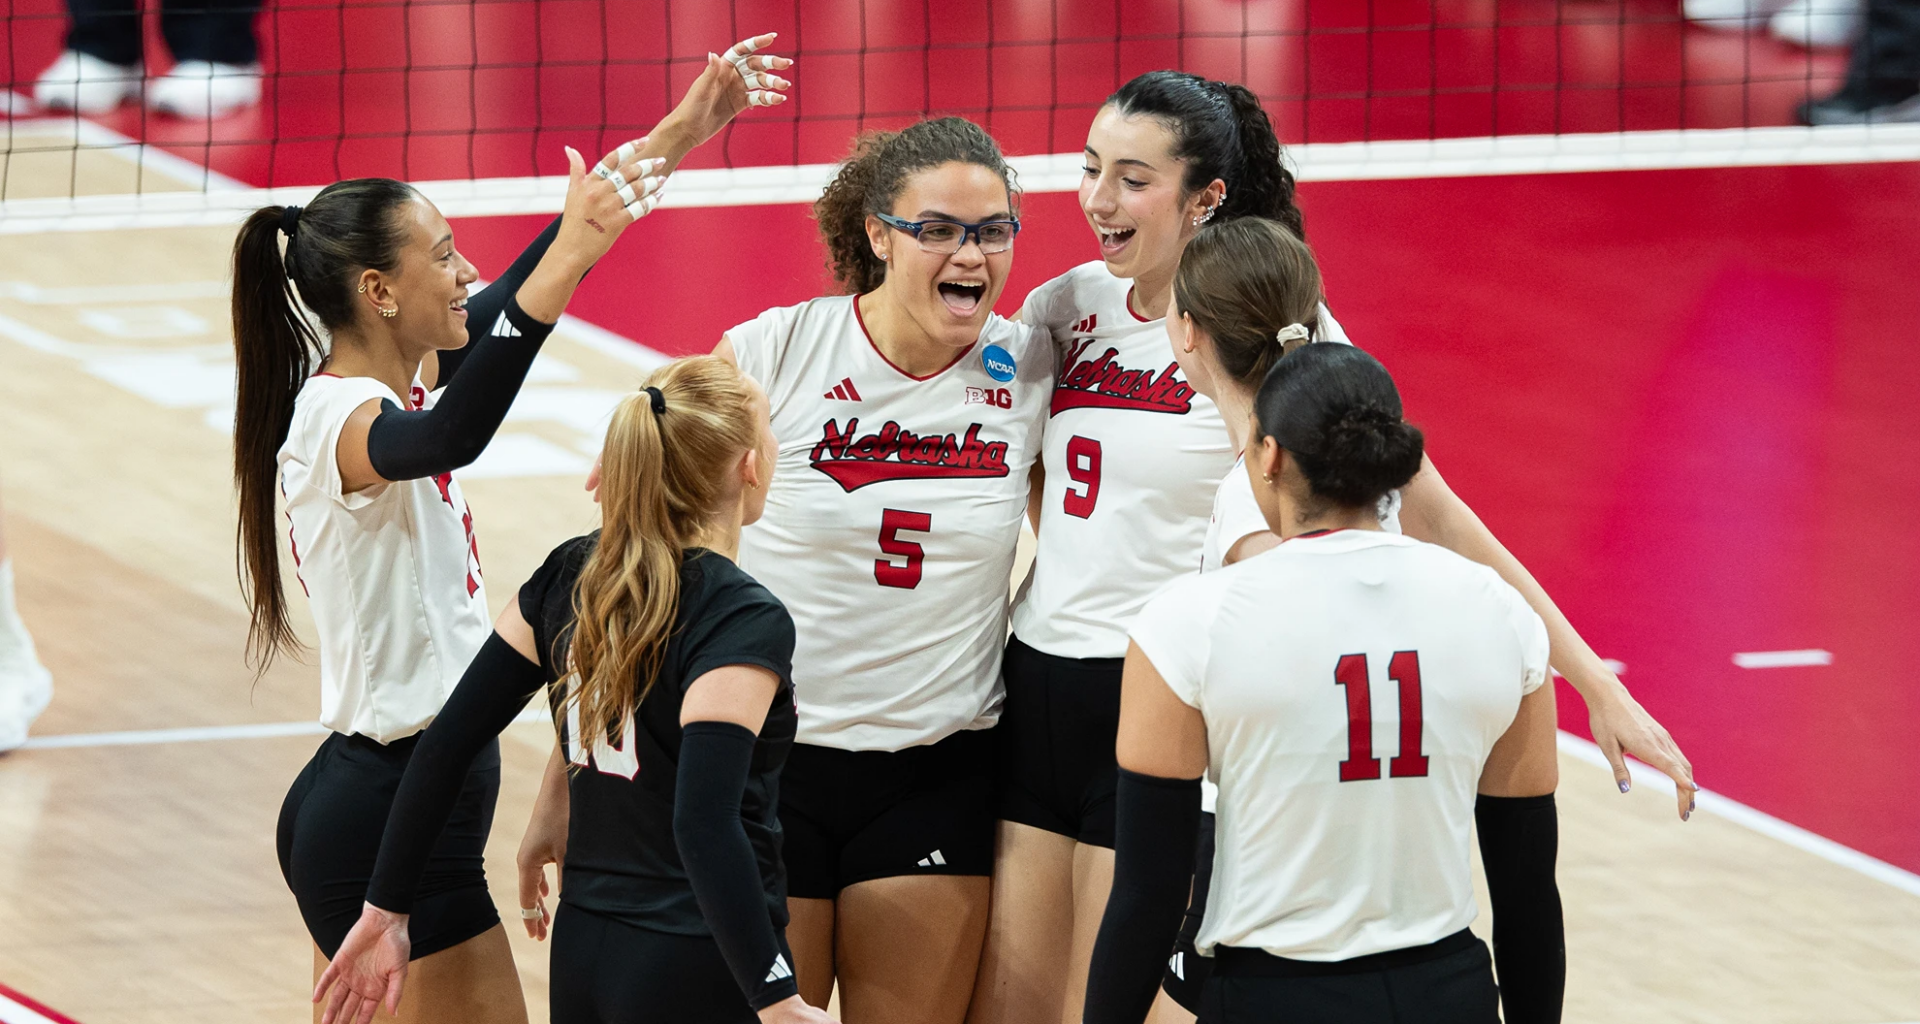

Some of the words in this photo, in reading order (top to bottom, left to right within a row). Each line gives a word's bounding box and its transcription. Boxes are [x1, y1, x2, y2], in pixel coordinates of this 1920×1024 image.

[987, 358, 1015, 376] NCAA
[809, 417, 1009, 473] Nebraska
[1063, 434, 1102, 520] 9
[874, 507, 932, 590] 5
[1333, 649, 1430, 783] 11
